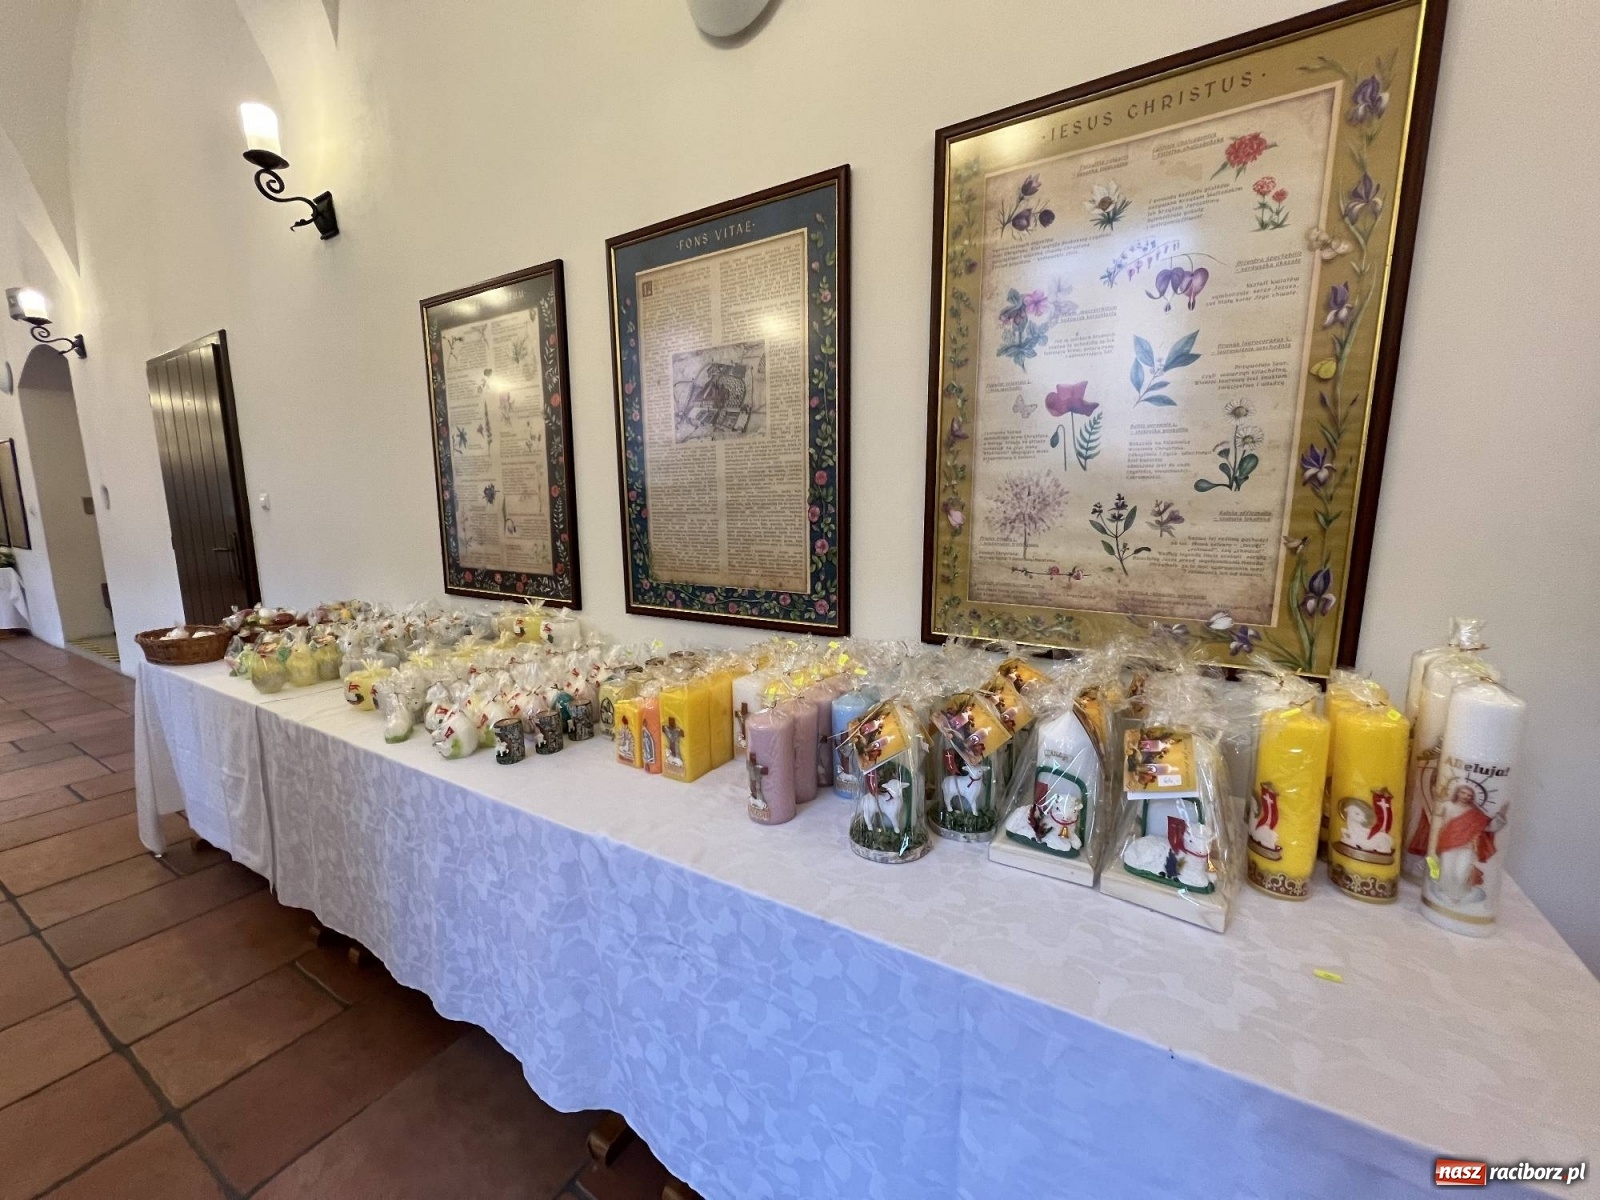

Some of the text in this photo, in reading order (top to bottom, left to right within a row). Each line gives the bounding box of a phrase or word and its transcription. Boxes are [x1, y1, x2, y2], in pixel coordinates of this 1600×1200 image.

[1127, 71, 1253, 120] CHRISTUS
[680, 221, 751, 250] FONS VITAE
